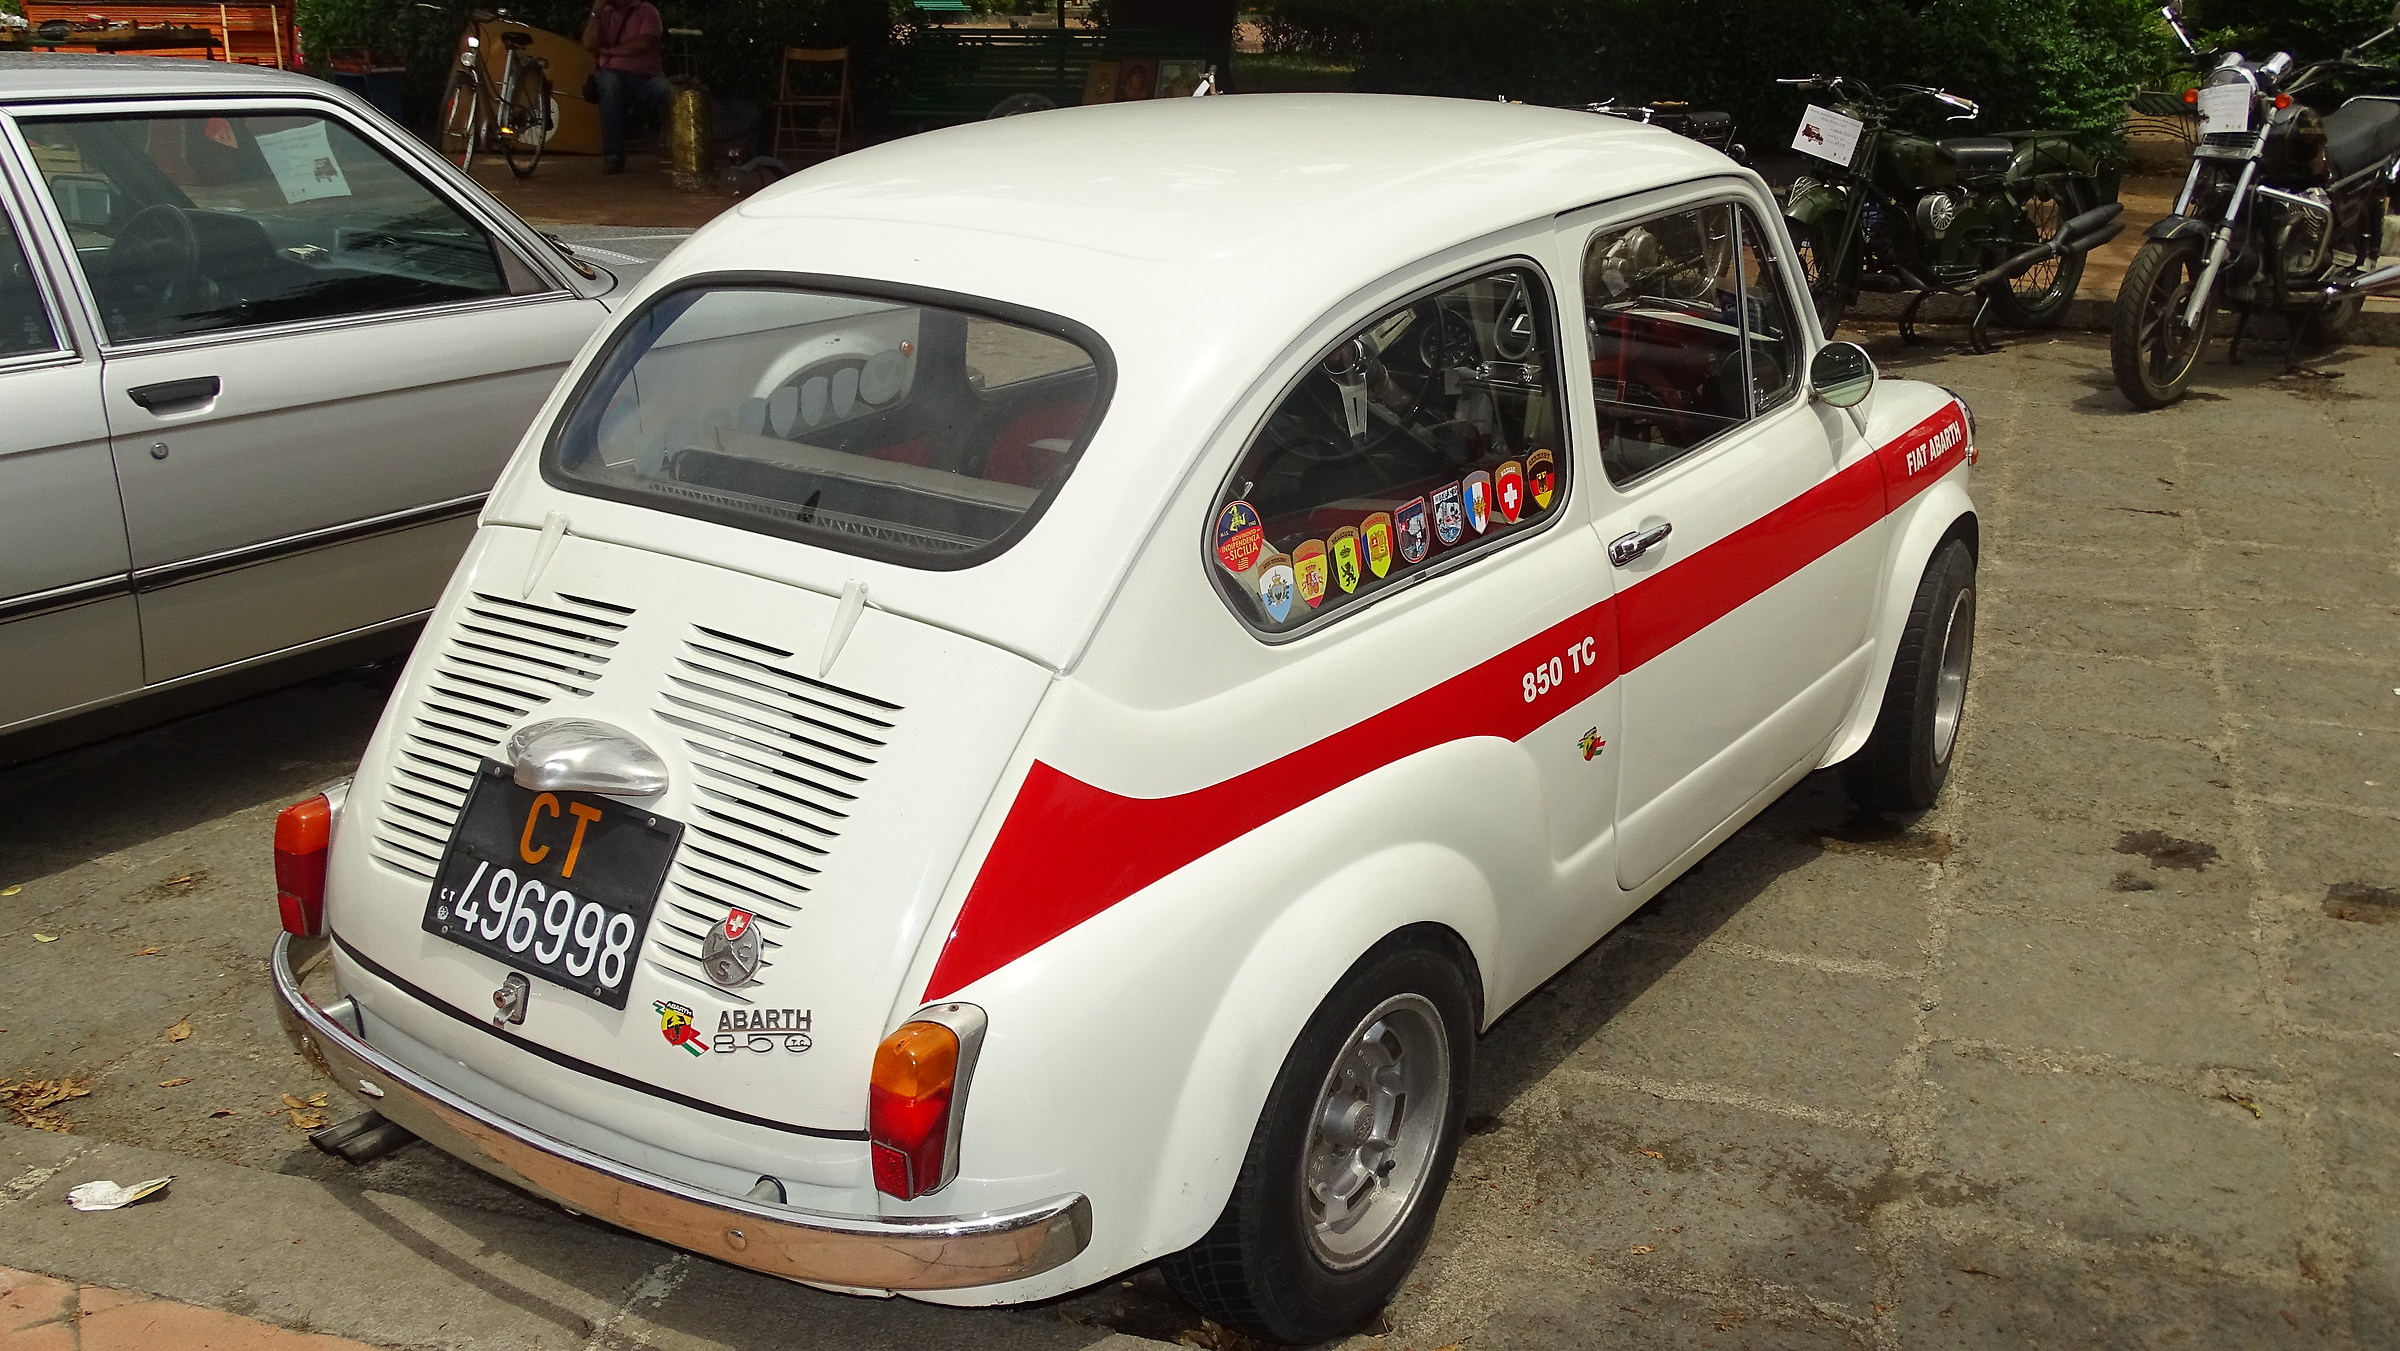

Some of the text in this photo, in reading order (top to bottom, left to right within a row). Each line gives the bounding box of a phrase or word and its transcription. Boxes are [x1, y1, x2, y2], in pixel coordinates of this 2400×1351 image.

[1906, 420, 1962, 476] FIAT ABARTH
[1229, 542, 1259, 561] SICILIA
[1522, 636, 1596, 703] 850 TC
[520, 792, 603, 878] CT
[454, 860, 635, 988] 496998
[666, 1002, 693, 1016] ABARTH
[718, 1009, 812, 1032] ABARTH
